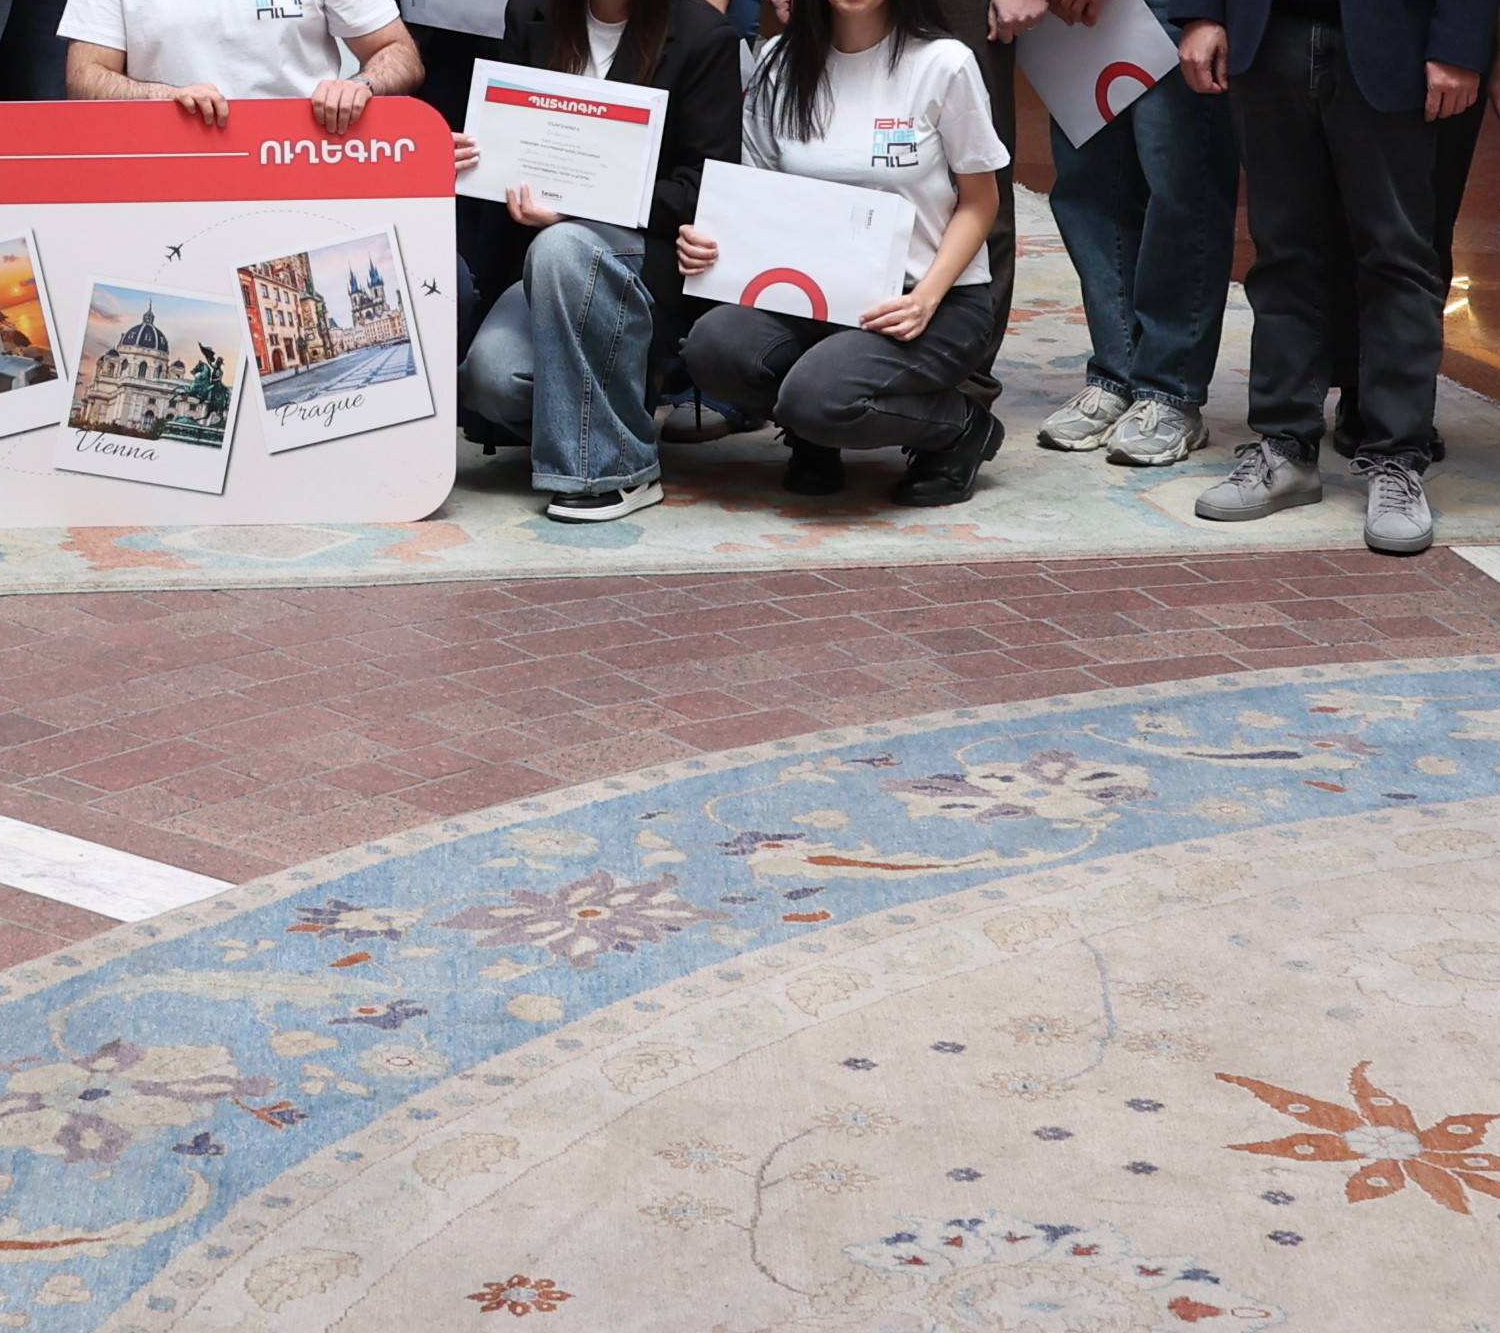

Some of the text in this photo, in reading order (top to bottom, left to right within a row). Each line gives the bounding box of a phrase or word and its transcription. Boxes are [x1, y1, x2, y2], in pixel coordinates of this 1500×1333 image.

[528, 95, 608, 116] ՊԱՏՎՈԳԻՐ
[260, 138, 416, 165] ՈՒՂԵԳԻՐ
[275, 394, 365, 427] Prague
[75, 428, 161, 462] Vienna
